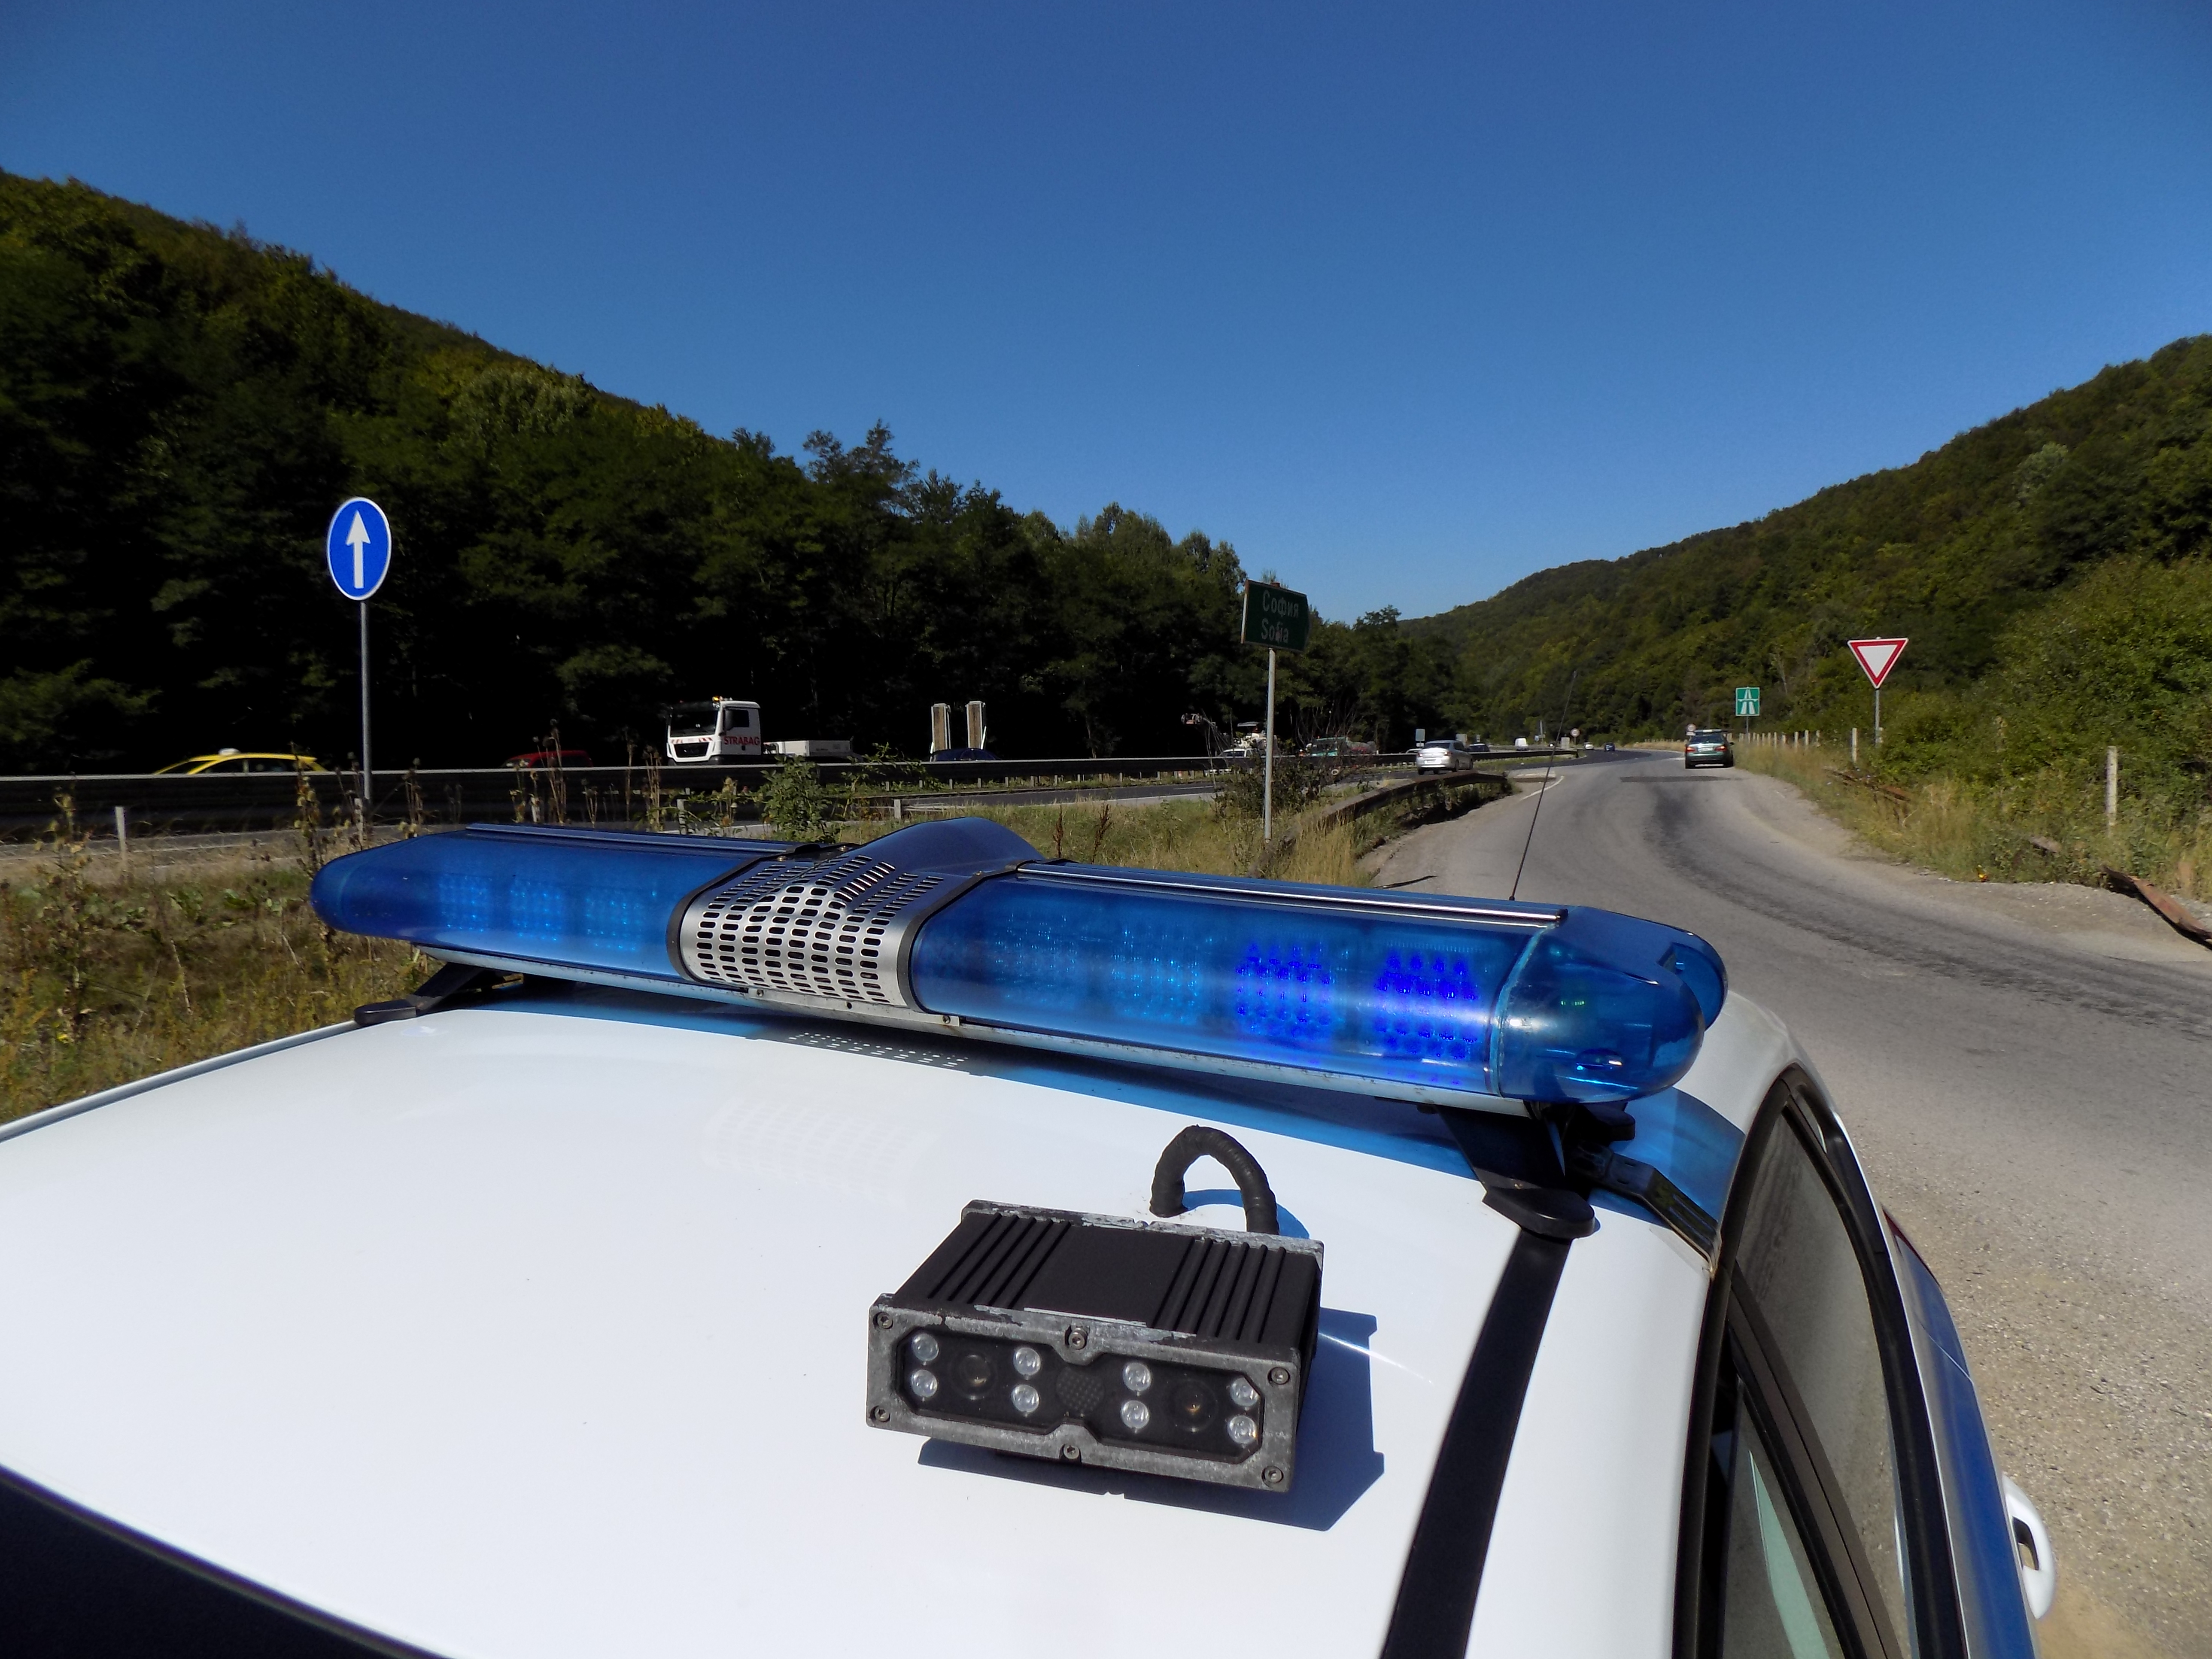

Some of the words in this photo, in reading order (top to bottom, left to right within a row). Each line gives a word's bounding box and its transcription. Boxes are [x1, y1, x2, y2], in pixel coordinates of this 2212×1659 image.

[1262, 590, 1299, 618] София
[1261, 617, 1288, 643] Sofia
[724, 736, 760, 745] STRABAG
